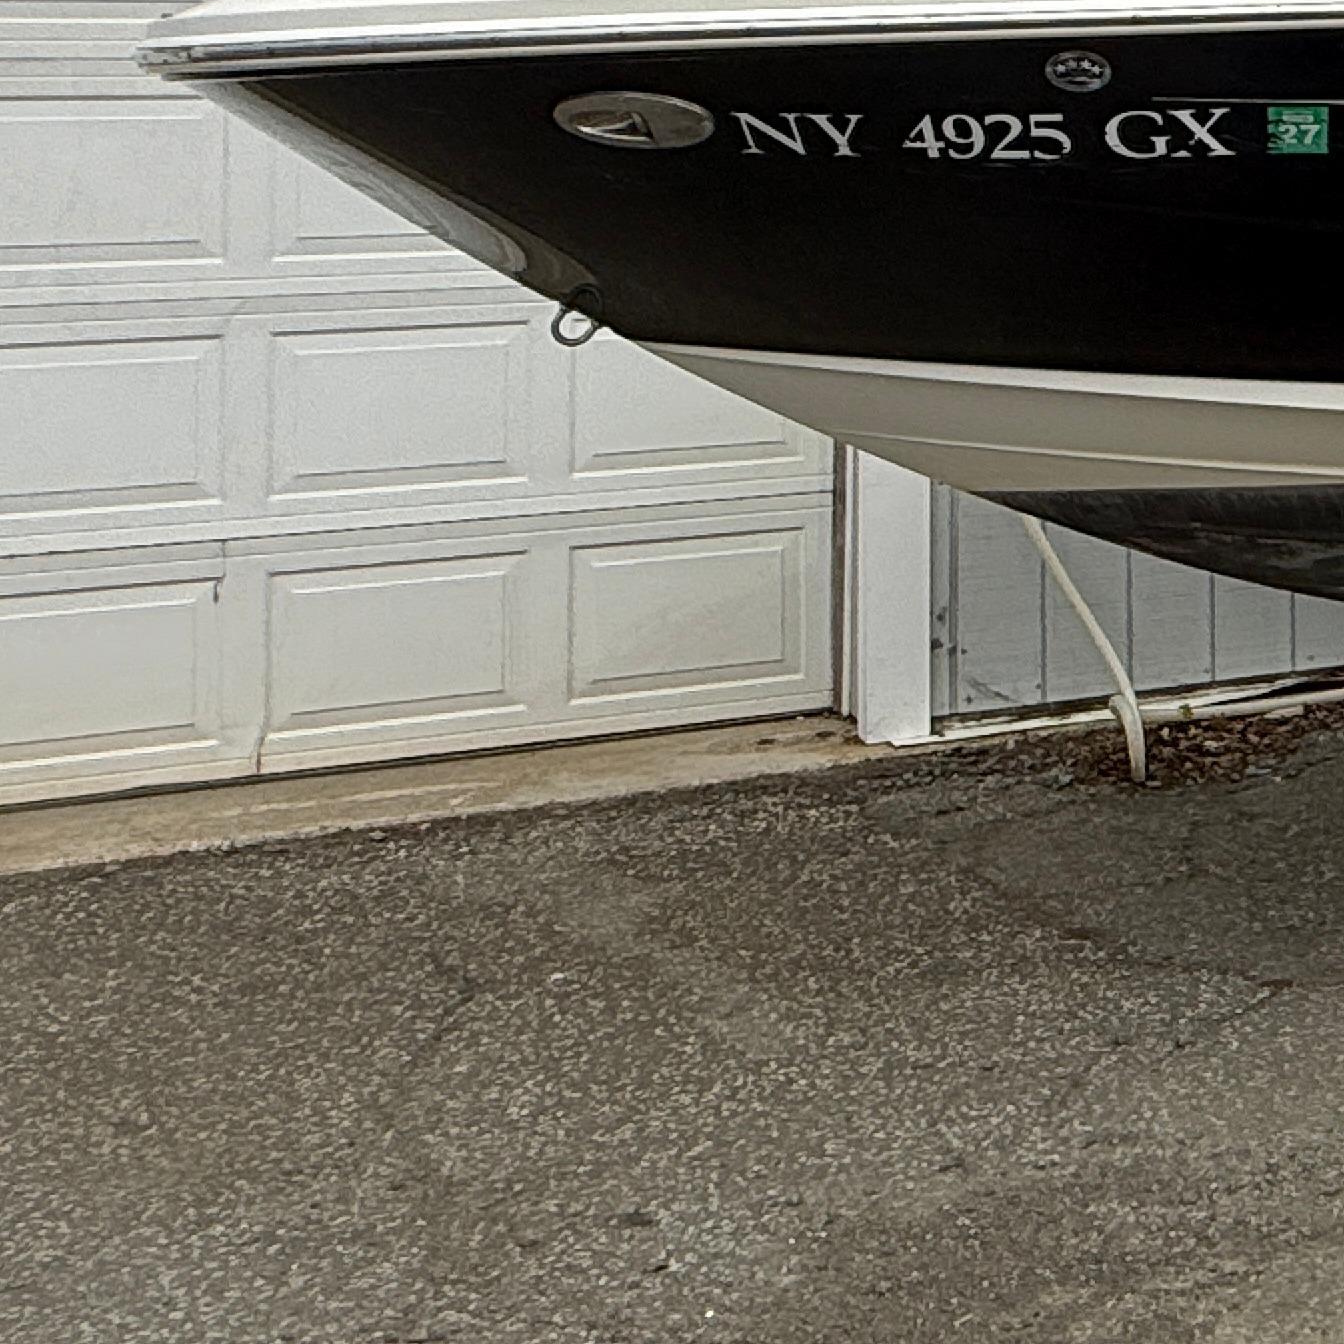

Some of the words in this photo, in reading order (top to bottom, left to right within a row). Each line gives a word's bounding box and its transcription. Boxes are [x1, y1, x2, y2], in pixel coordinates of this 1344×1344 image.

[732, 111, 862, 156] NY
[902, 114, 1072, 160] 4925
[1104, 108, 1236, 158] GX
[1278, 124, 1321, 145] 27
